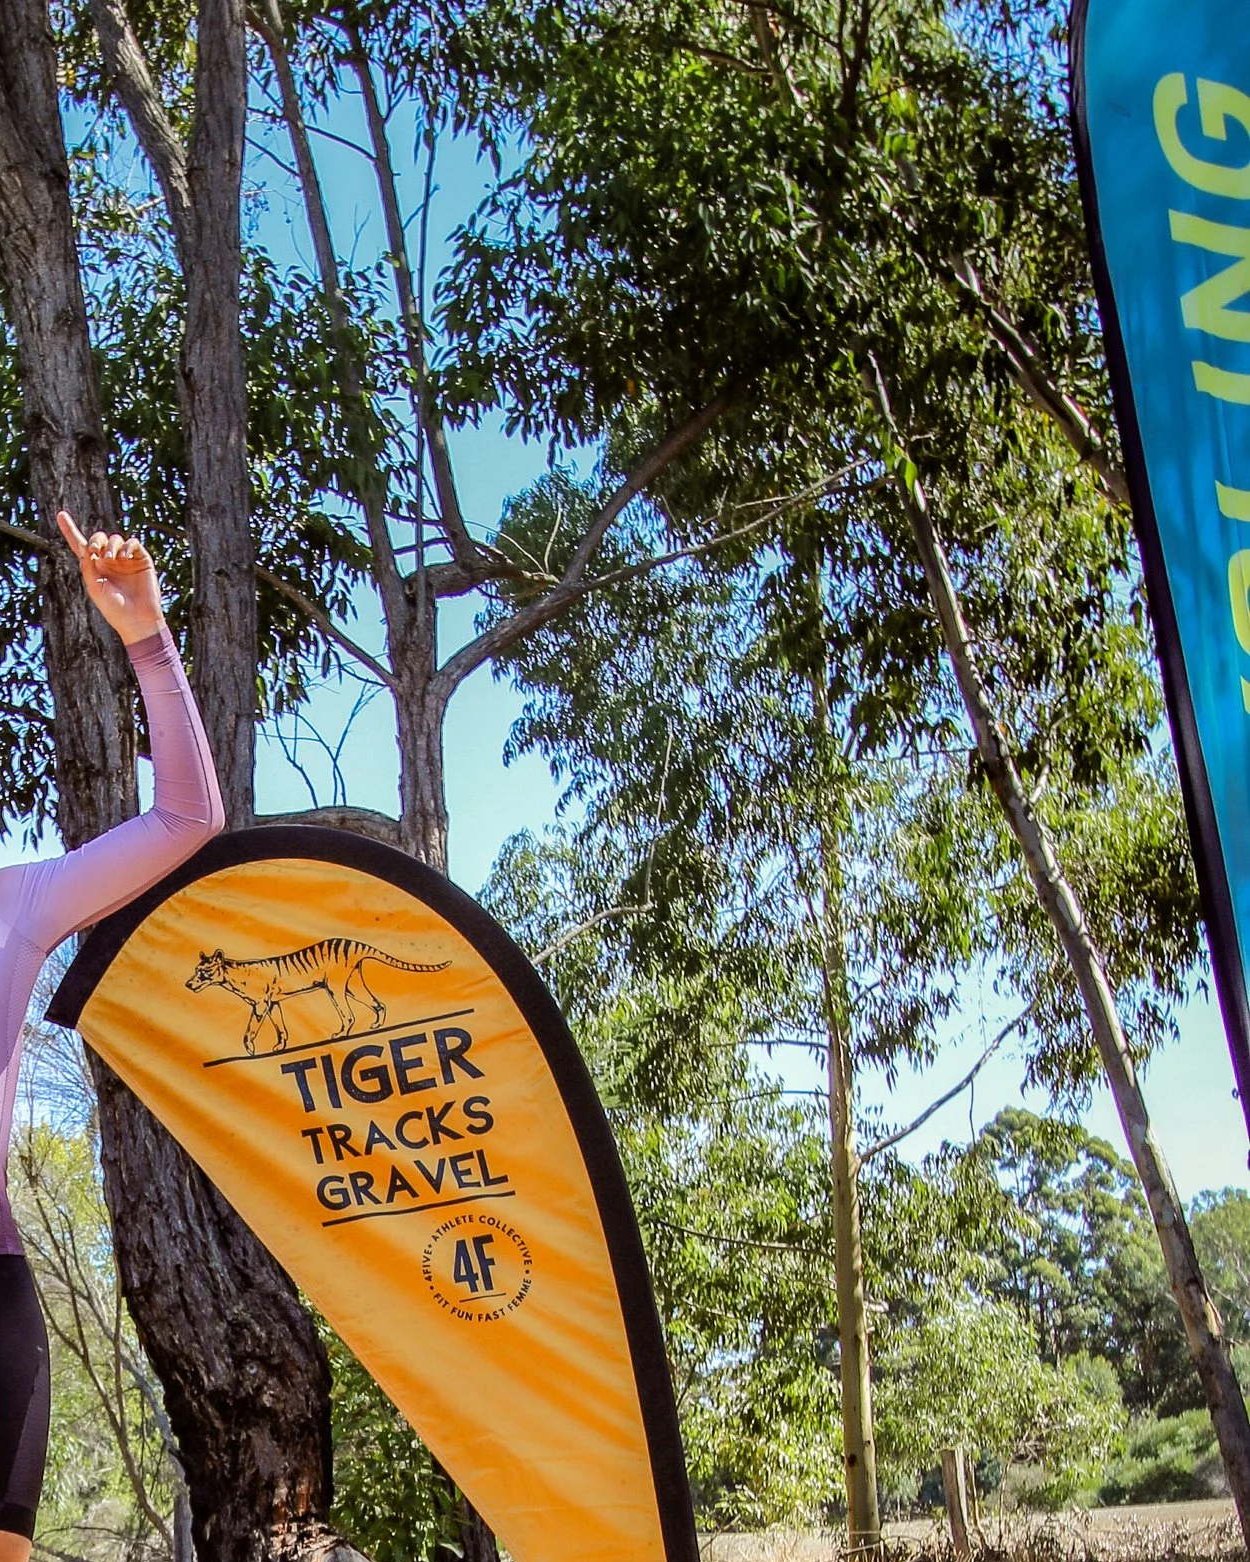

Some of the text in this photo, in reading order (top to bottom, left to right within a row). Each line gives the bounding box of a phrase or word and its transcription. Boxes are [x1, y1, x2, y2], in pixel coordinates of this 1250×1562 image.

[280, 1027, 485, 1113] TIGER
[301, 1096, 494, 1165] TRACKS
[316, 1149, 509, 1211] GRAVEL
[431, 1214, 474, 1242] ATHLETE
[478, 1215, 533, 1266] COLLECTIVE
[453, 1233, 496, 1293] 4F
[433, 1278, 532, 1323] FIT FUN FAST FEMME
